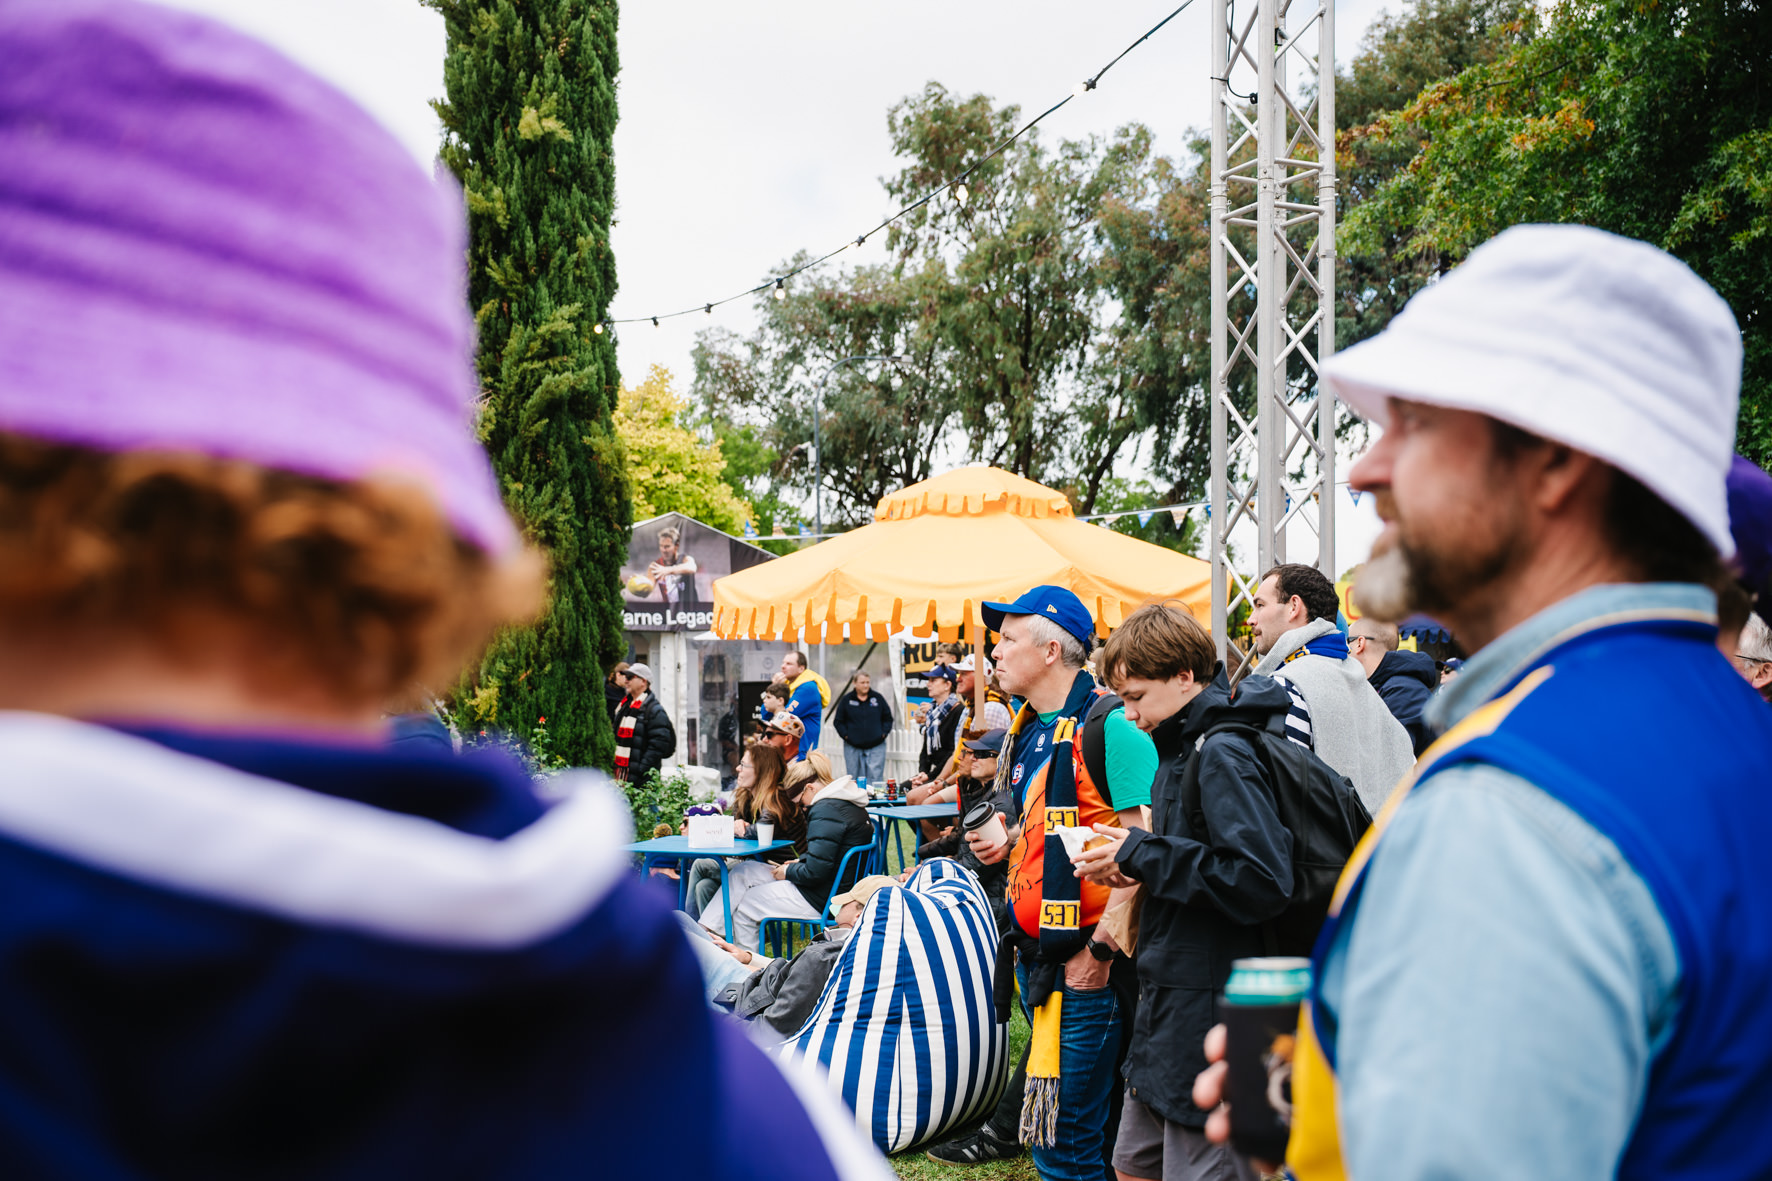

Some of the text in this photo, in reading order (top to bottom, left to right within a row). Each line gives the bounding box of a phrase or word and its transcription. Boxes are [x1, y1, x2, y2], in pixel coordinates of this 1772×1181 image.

[621, 609, 713, 629] arne Legac
[1046, 810, 1079, 832] LES
[1043, 903, 1080, 926] LES
